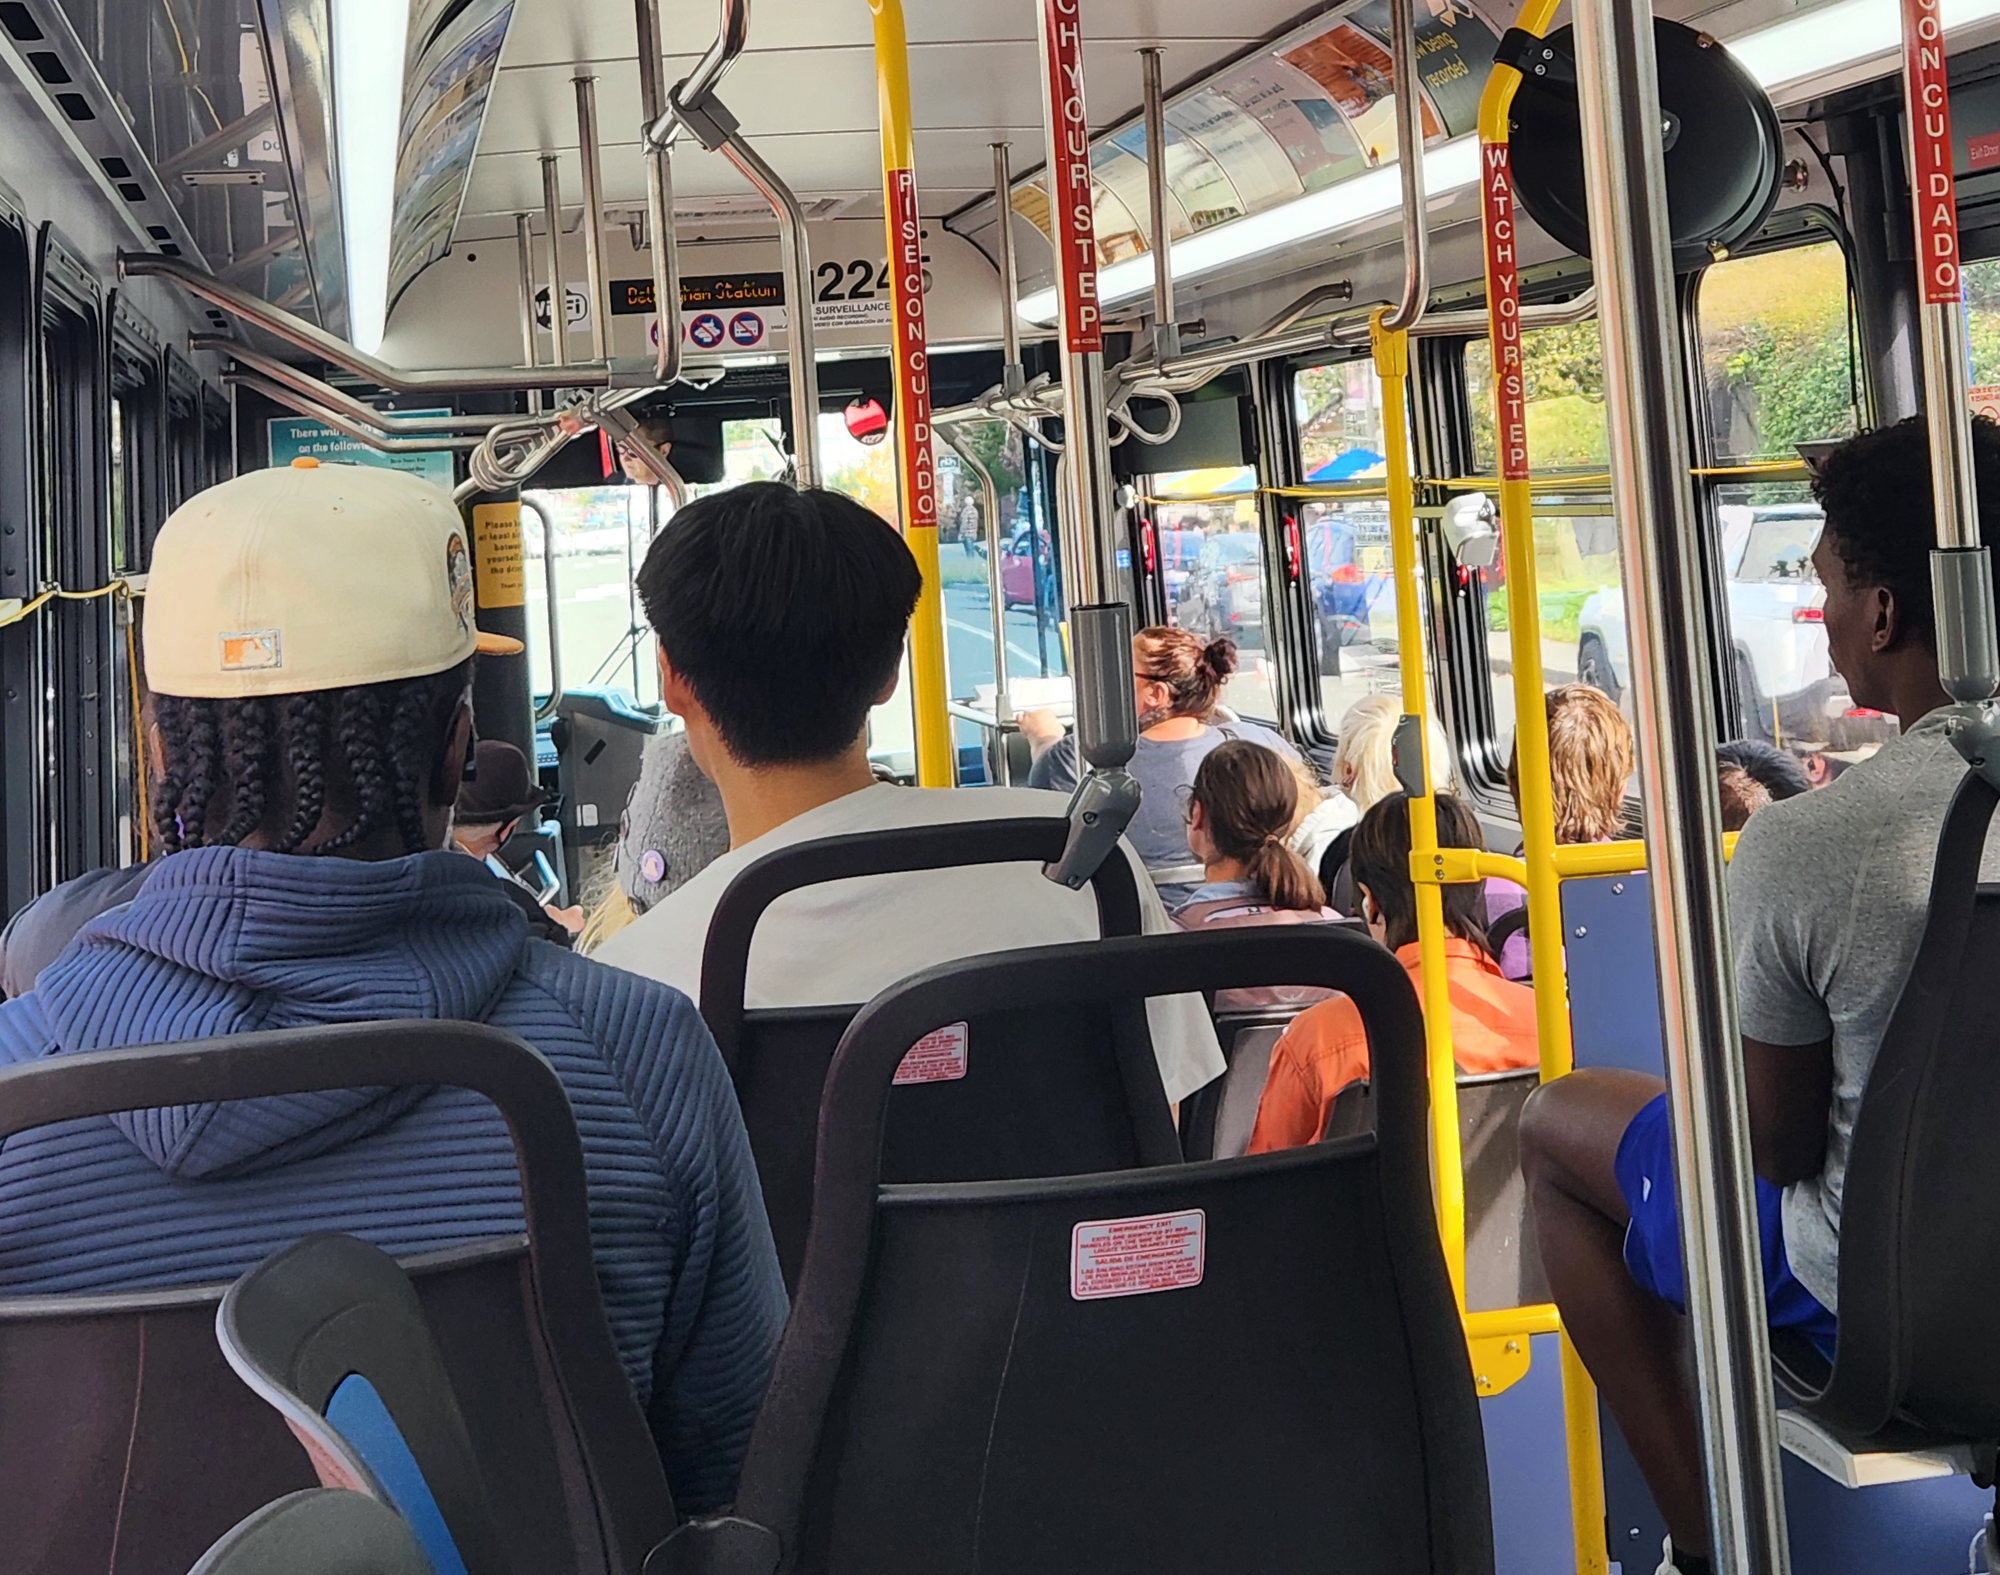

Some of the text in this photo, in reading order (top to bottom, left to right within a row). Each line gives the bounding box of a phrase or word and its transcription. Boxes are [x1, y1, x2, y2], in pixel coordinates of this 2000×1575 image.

[1416, 30, 1459, 51] being
[1425, 52, 1470, 88] recorded
[1062, 63, 1090, 189] YOUR
[1970, 144, 1999, 160] Exit Door
[1922, 84, 1956, 286] CUIDADO
[1486, 148, 1512, 264] WATCH
[899, 174, 918, 264] PISE
[1073, 205, 1098, 332] STEP
[715, 281, 777, 300] Station
[816, 302, 890, 315] SURVEILLANCE
[904, 274, 923, 341] CON
[1498, 274, 1519, 366] YOUR
[1506, 376, 1525, 468] STEP
[290, 428, 318, 438] There
[909, 352, 934, 514] CUIDADO
[312, 442, 328, 453] the
[484, 520, 513, 530] Please
[490, 532, 510, 540] least
[486, 552, 520, 564] yourself
[490, 566, 504, 574] the
[1108, 1220, 1172, 1234] EMERGENCY EXIT
[1095, 1257, 1122, 1266] SALIDA
[1136, 1249, 1184, 1261] EMERGENCIA
